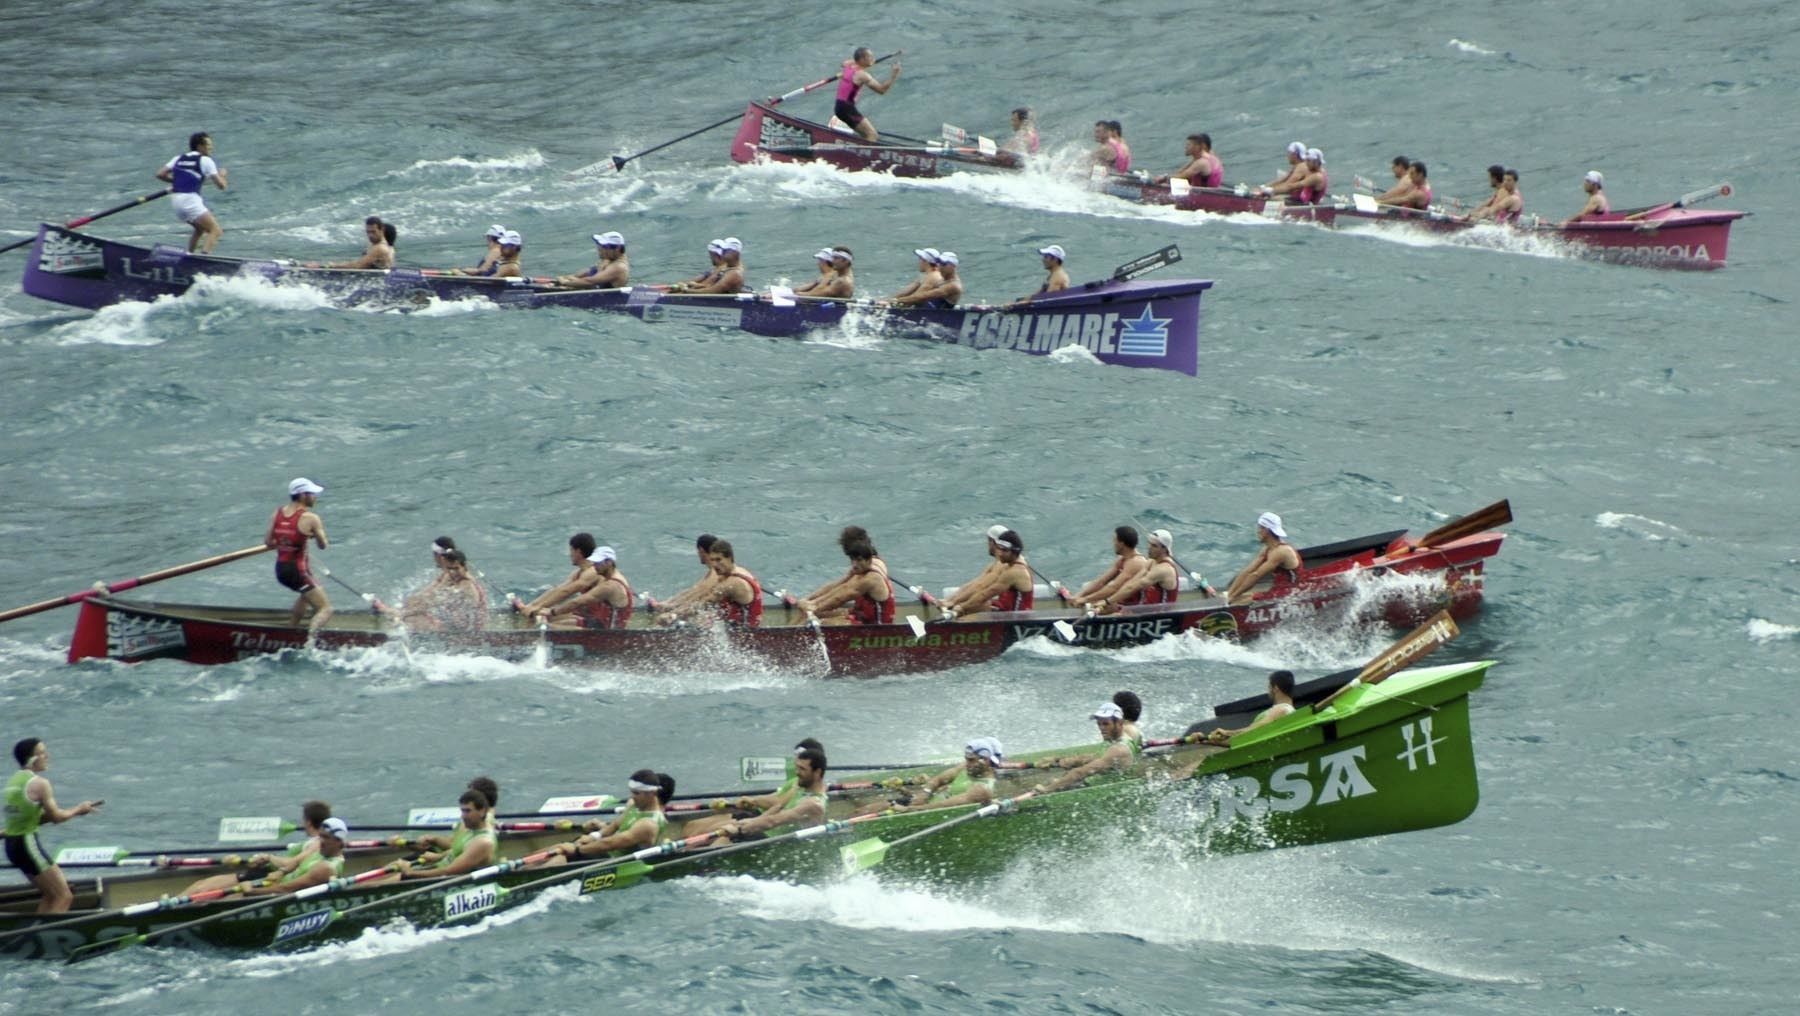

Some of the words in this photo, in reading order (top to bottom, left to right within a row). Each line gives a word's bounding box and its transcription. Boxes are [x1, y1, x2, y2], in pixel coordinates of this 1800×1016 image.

[1588, 244, 1711, 262] RDROLA
[959, 312, 1120, 354] ECOLMARE
[449, 890, 496, 916] alkain
